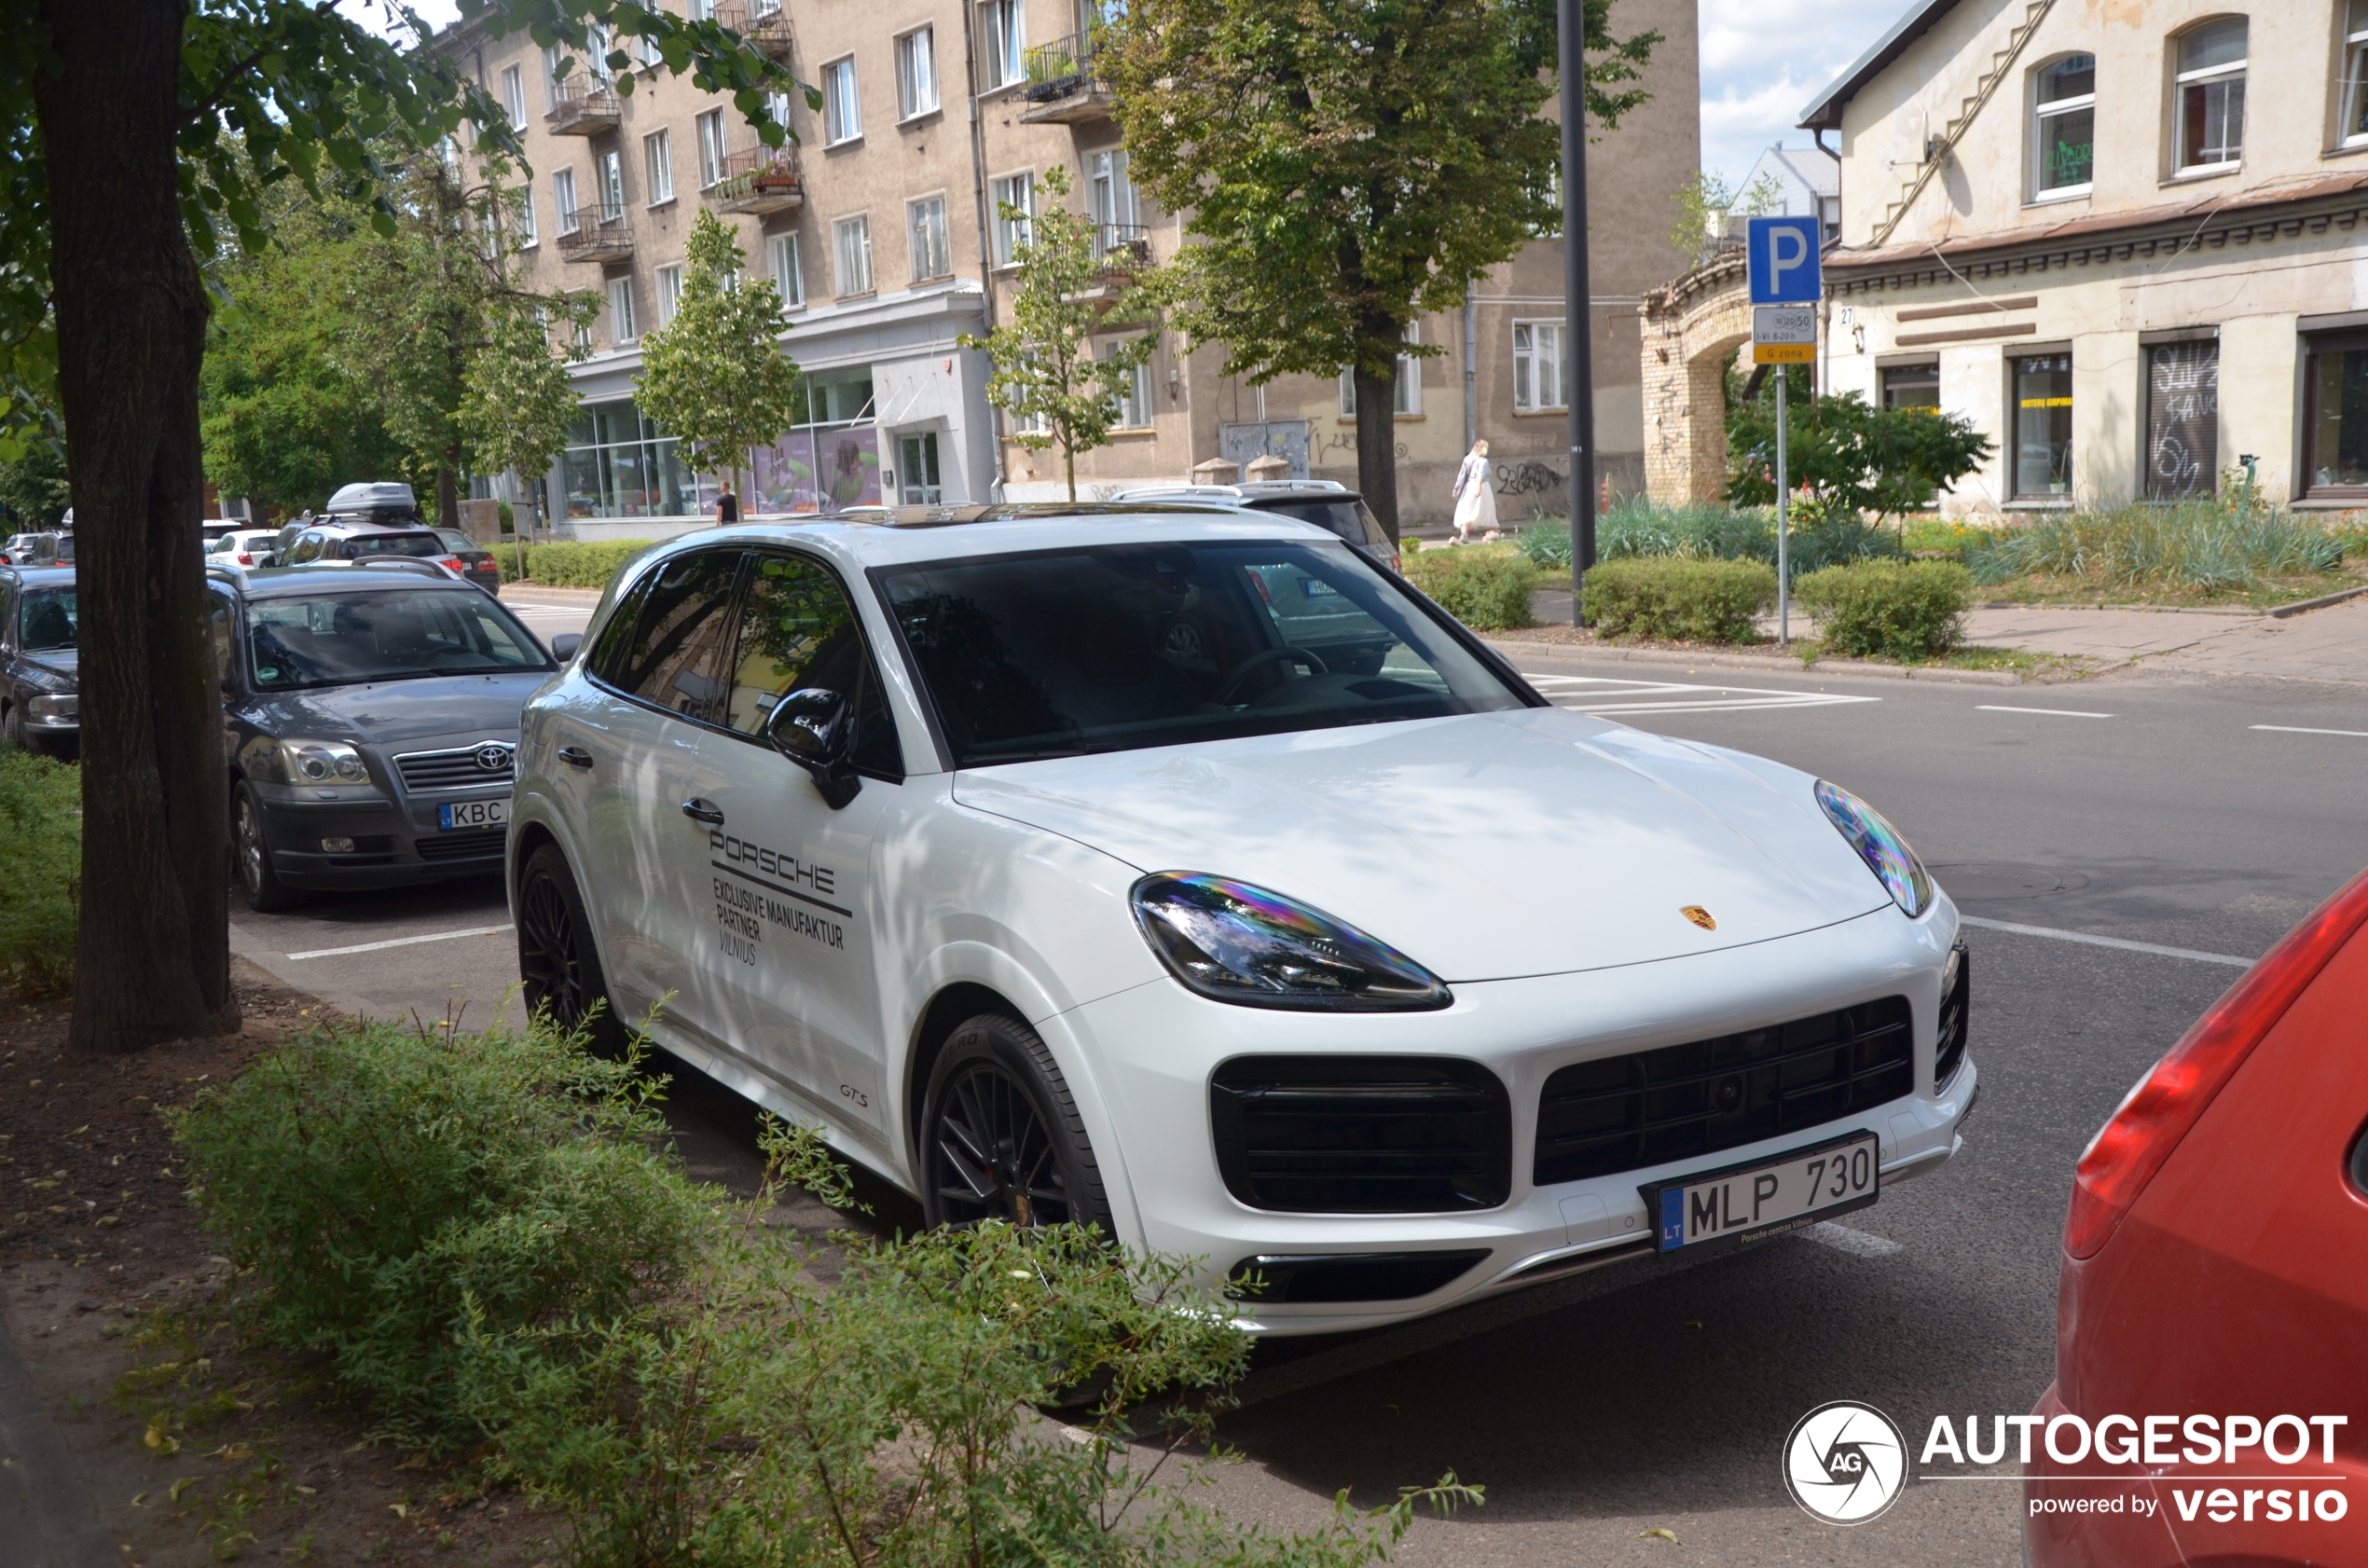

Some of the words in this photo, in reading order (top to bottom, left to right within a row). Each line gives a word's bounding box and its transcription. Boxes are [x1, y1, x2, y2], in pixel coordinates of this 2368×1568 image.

[1769, 226, 1808, 296] P
[1785, 317, 1795, 325] 20
[1797, 315, 1810, 326] 50
[1841, 309, 1852, 323] 27
[1756, 332, 1769, 340] I-VI
[1773, 332, 1789, 340] 8-20
[1768, 349, 1774, 358] G
[1779, 350, 1803, 358] zona
[1571, 445, 1582, 453] 141
[454, 803, 502, 825] KBC
[709, 830, 834, 895] PORSCHE
[713, 877, 766, 919] EXCLUSIVE
[766, 899, 844, 950] MANUFAKTUR
[716, 904, 762, 942] PARTNER
[719, 928, 756, 967] VILNIUS
[840, 1083, 868, 1107] GTS
[1691, 1173, 1778, 1237] MLP
[1807, 1148, 1869, 1206] 730
[1664, 1224, 1681, 1240] LT
[1741, 1230, 1767, 1244] Porsche
[1768, 1223, 1792, 1236] centras
[1792, 1217, 1813, 1229] Vilnius
